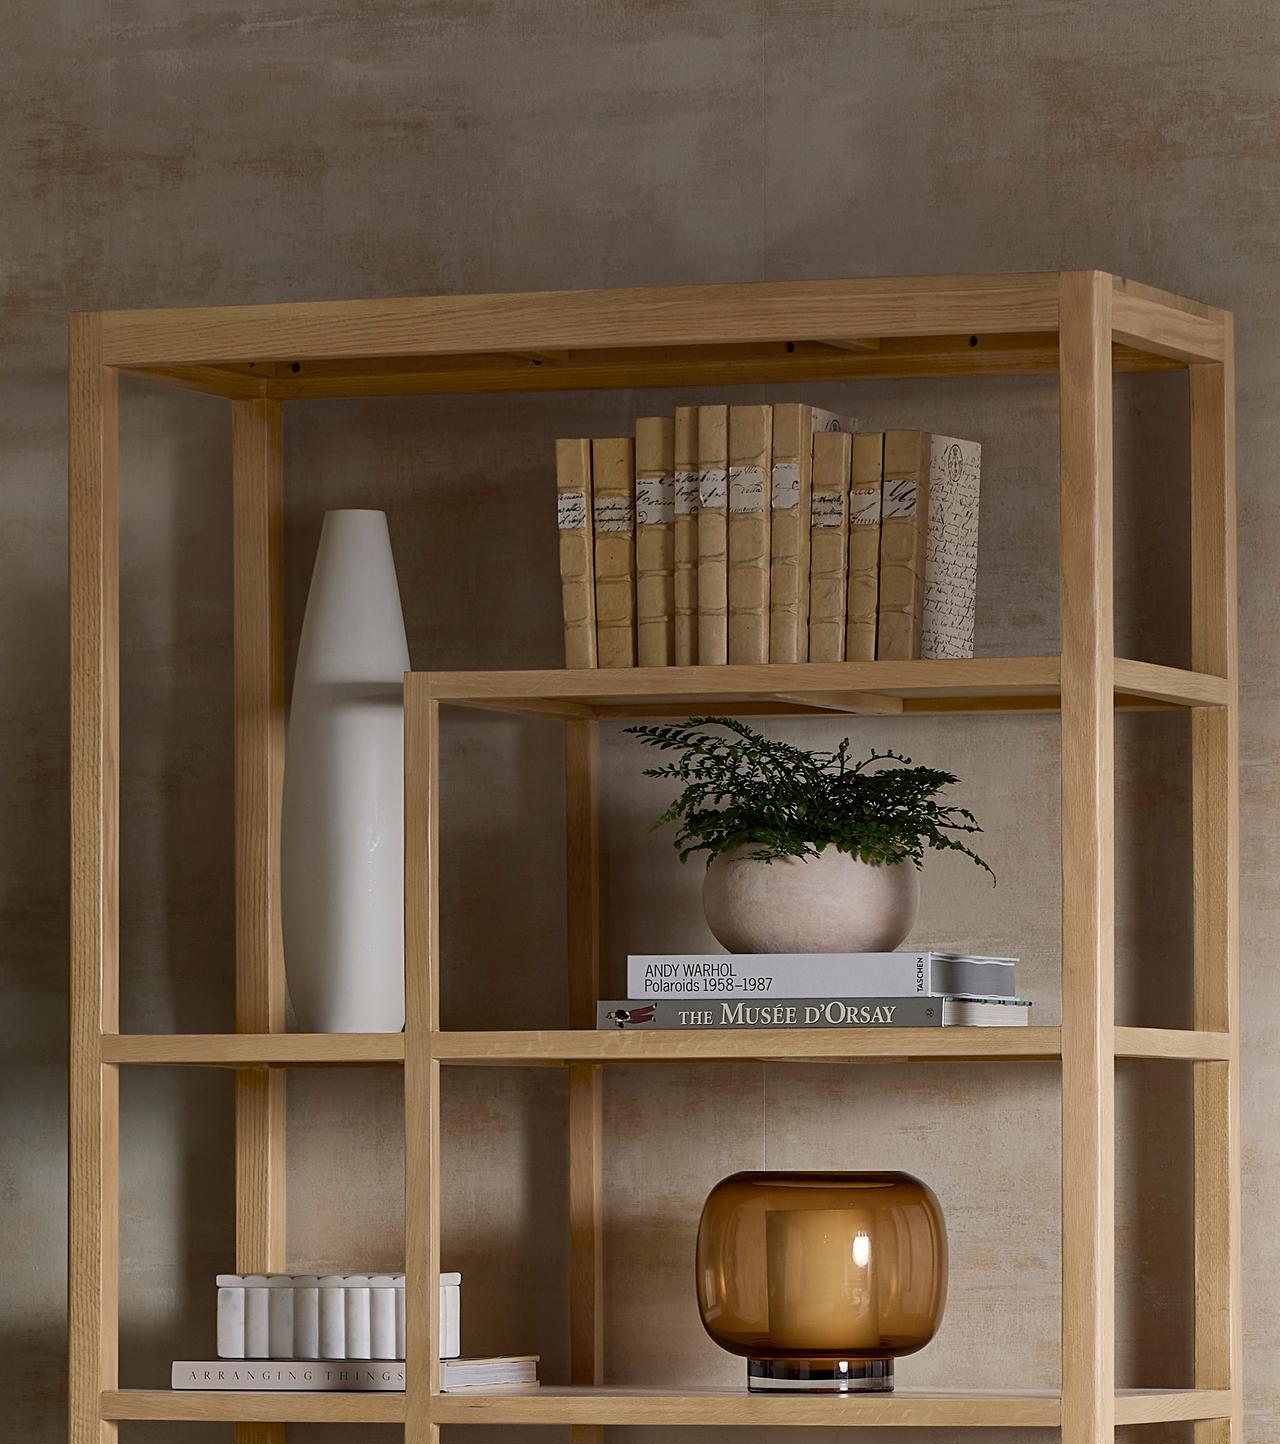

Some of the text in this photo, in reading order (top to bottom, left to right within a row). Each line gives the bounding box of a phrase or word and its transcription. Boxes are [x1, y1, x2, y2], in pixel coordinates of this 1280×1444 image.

[644, 962, 737, 978] ANDY WARHOL
[916, 957, 924, 993] TASCHEN
[643, 978, 700, 993] Polaroids
[678, 1010, 713, 1025] THE
[188, 1370, 404, 1382] ARRANGING THINGS
